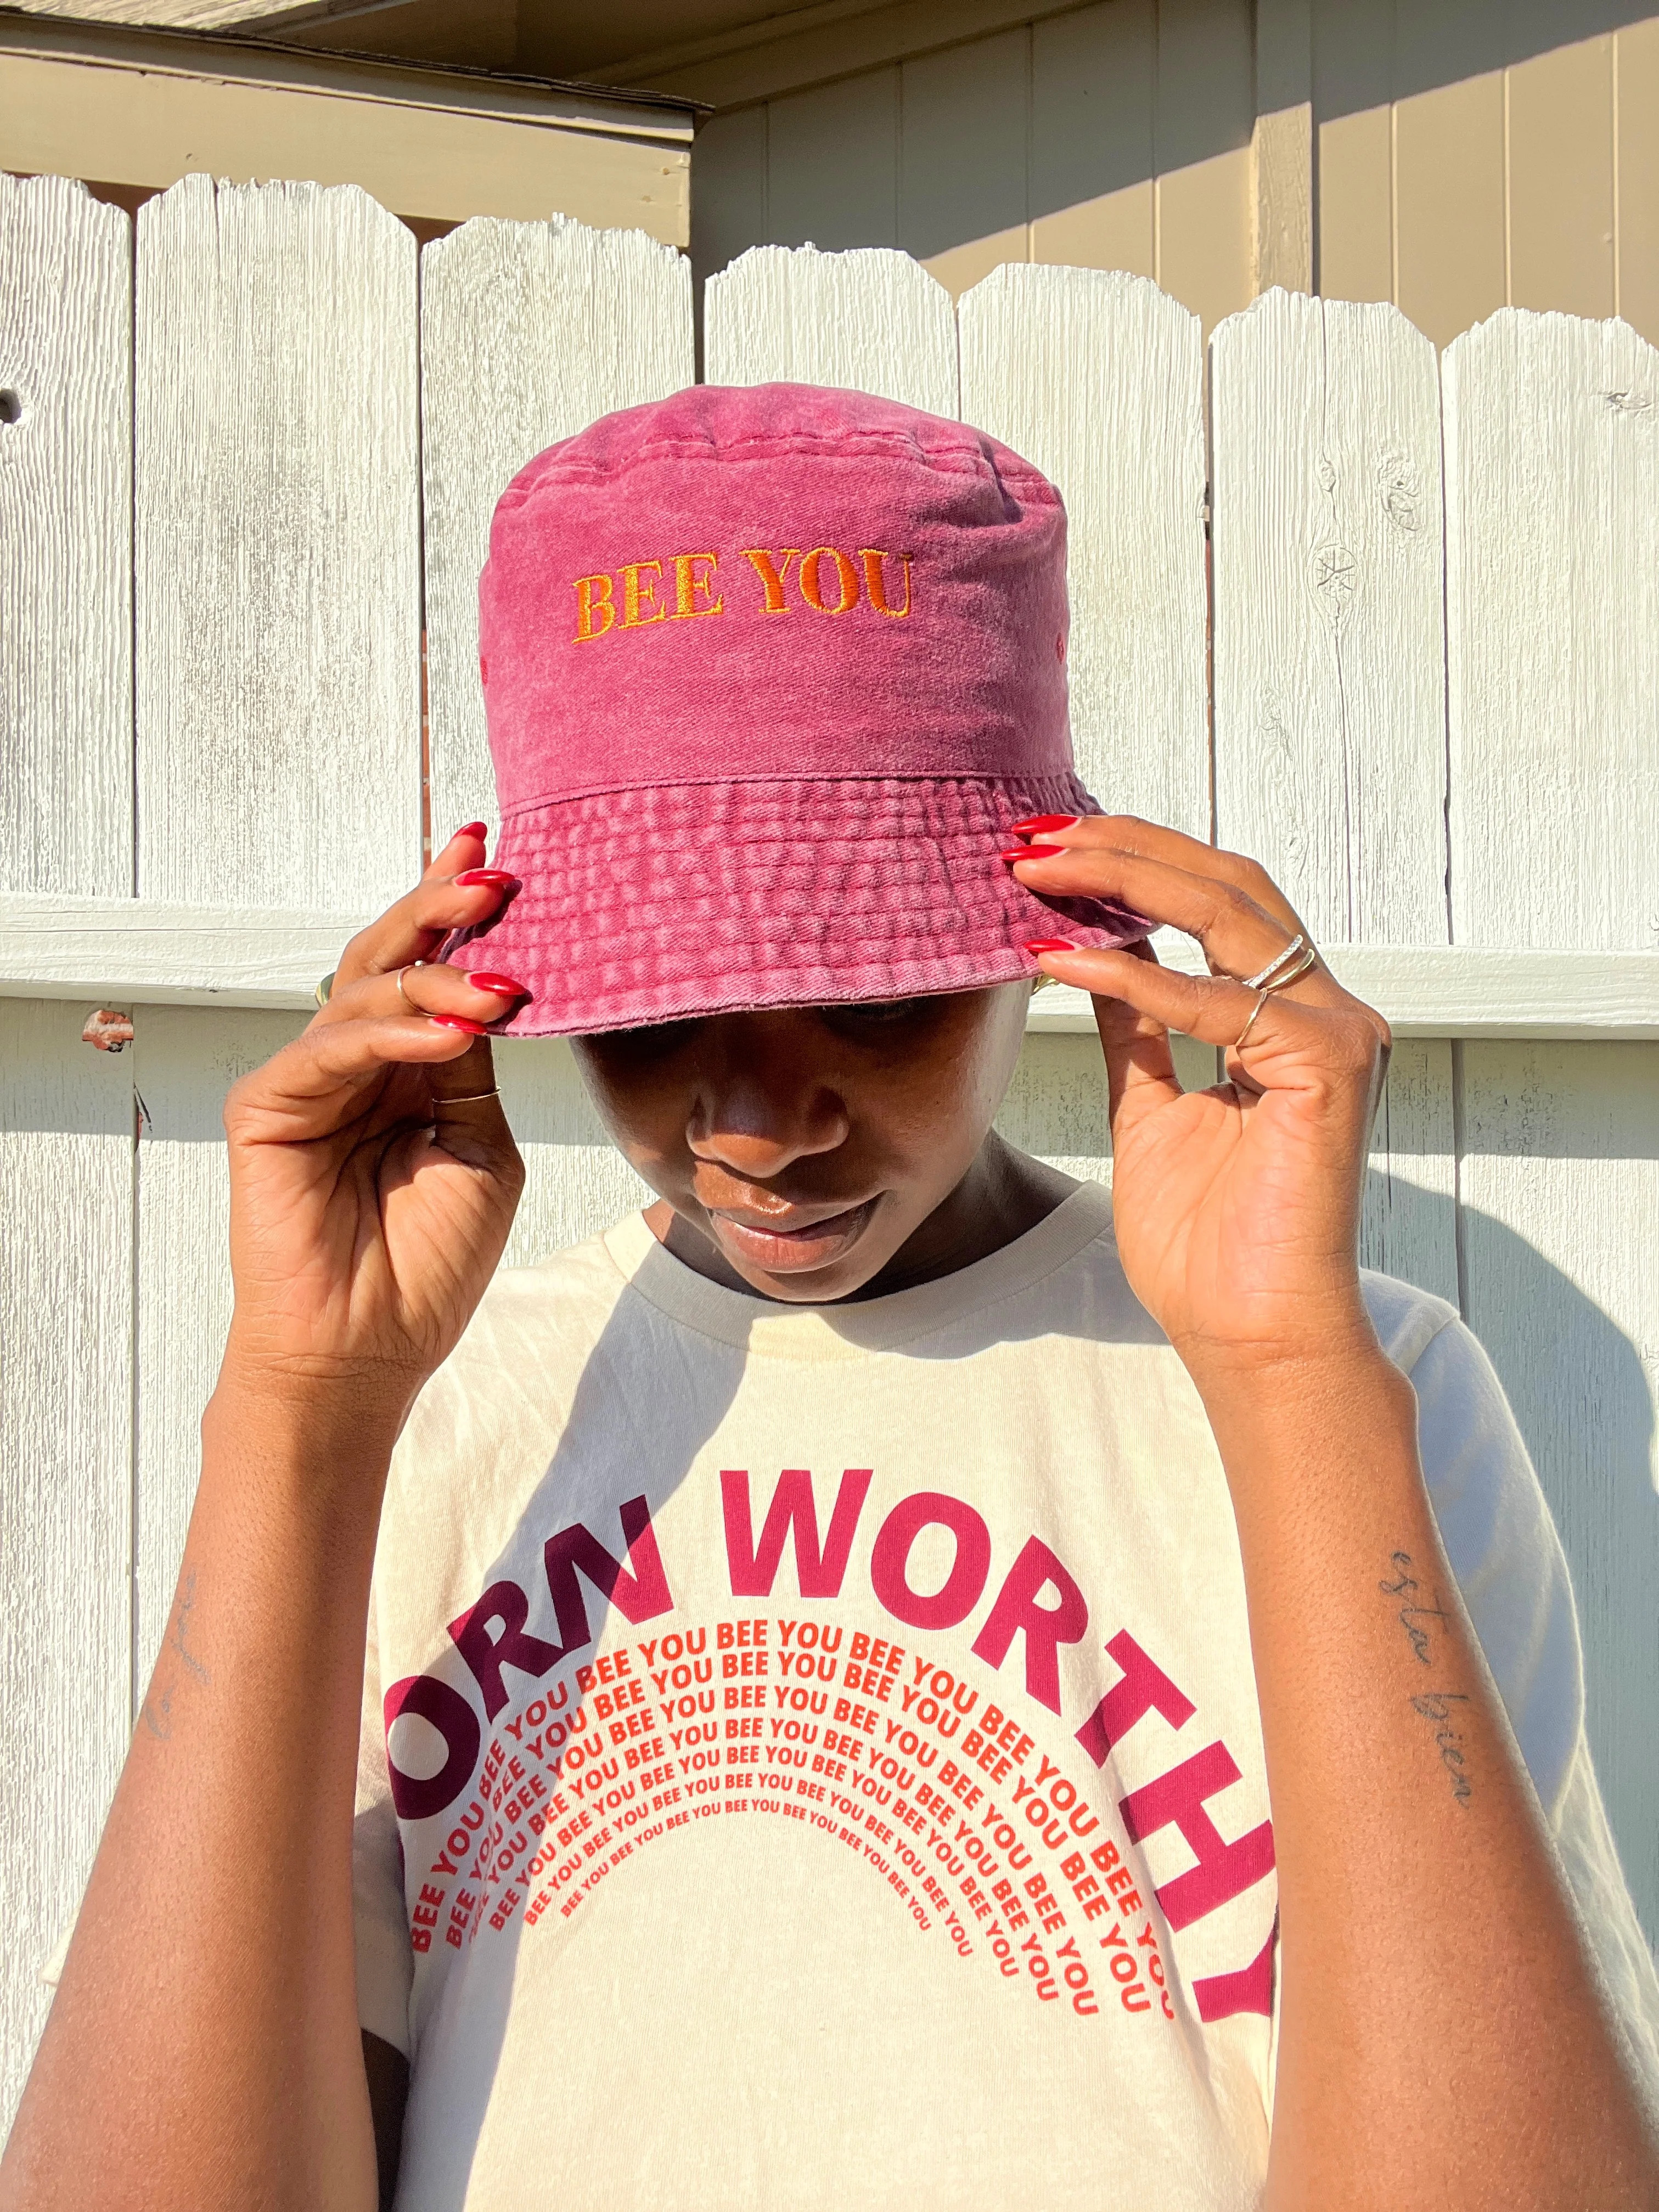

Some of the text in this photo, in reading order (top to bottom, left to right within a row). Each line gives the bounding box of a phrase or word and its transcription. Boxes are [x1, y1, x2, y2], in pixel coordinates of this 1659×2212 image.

[572, 547, 913, 644] BEE YOU
[384, 1494, 674, 1888] ORN
[411, 1883, 446, 1952] BEE
[431, 1801, 485, 1876] YOU
[479, 1740, 507, 1801] BEE
[504, 1681, 569, 1741] YOU
[575, 1648, 632, 1695] BEE
[637, 1626, 707, 1668] YOU
[716, 1619, 768, 1650] BEE
[777, 1619, 843, 1654] YOU
[848, 1631, 906, 1676] BEE
[913, 1656, 980, 1715] YOU
[978, 1703, 1036, 1766] BEE
[1034, 1754, 1100, 1837] YOU
[1089, 1839, 1144, 1917] BEE
[445, 1888, 476, 1948] BEE
[469, 1822, 504, 1879] YOU
[492, 1755, 526, 1812] BEE
[526, 1706, 588, 1761] YOU
[593, 1678, 646, 1721] BEE
[650, 1657, 713, 1696] YOU
[722, 1651, 769, 1679] BEE
[777, 1650, 838, 1682] YOU
[842, 1662, 895, 1703] BEE
[901, 1684, 961, 1738] YOU
[960, 1728, 1014, 1785] BEE
[1011, 1775, 1069, 1850] YOU
[1059, 1850, 1111, 1922] BEE
[1099, 1922, 1152, 2013] YOU
[487, 1716, 1060, 2002] YOU BEE YOU BEE YOU BEE YOU BEE YOU BEE YOU BEE YOU
[489, 1888, 520, 1931] BEE
[515, 1842, 557, 1887] YOU
[556, 1810, 593, 1848] BEE
[591, 1780, 636, 1817] YOU
[639, 1762, 676, 1792] BEE
[678, 1748, 721, 1775] YOU
[726, 1744, 760, 1765] BEE
[765, 1744, 808, 1769] YOU
[811, 1753, 848, 1782] BEE
[851, 1769, 893, 1806] YOU
[891, 1797, 927, 1836] BEE
[926, 1827, 965, 1877] YOU
[959, 1875, 993, 1921] BEE
[985, 1919, 1020, 1977] YOU
[504, 1684, 1099, 2016] BEE YOU BEE YOU BEE YOU BEE YOU BEE YOU BEE YOU
[522, 1890, 552, 1927] BEE
[547, 1853, 583, 1891] YOU
[582, 1827, 613, 1859] BEE
[611, 1802, 649, 1833] YOU
[651, 1787, 682, 1812] BEE
[684, 1775, 721, 1798] YOU
[724, 1772, 753, 1790] BEE
[757, 1772, 794, 1792] YOU
[796, 1778, 826, 1803] BEE
[830, 1791, 865, 1822] YOU
[864, 1814, 895, 1845] BEE
[894, 1838, 927, 1877] YOU
[921, 1875, 950, 1912] BEE
[944, 1910, 974, 1957] YOU
[560, 1798, 932, 1931] BEE YOU BEE YOU BEE YOU BEE YOU BEE YOU BEE YOU BEE YOU
